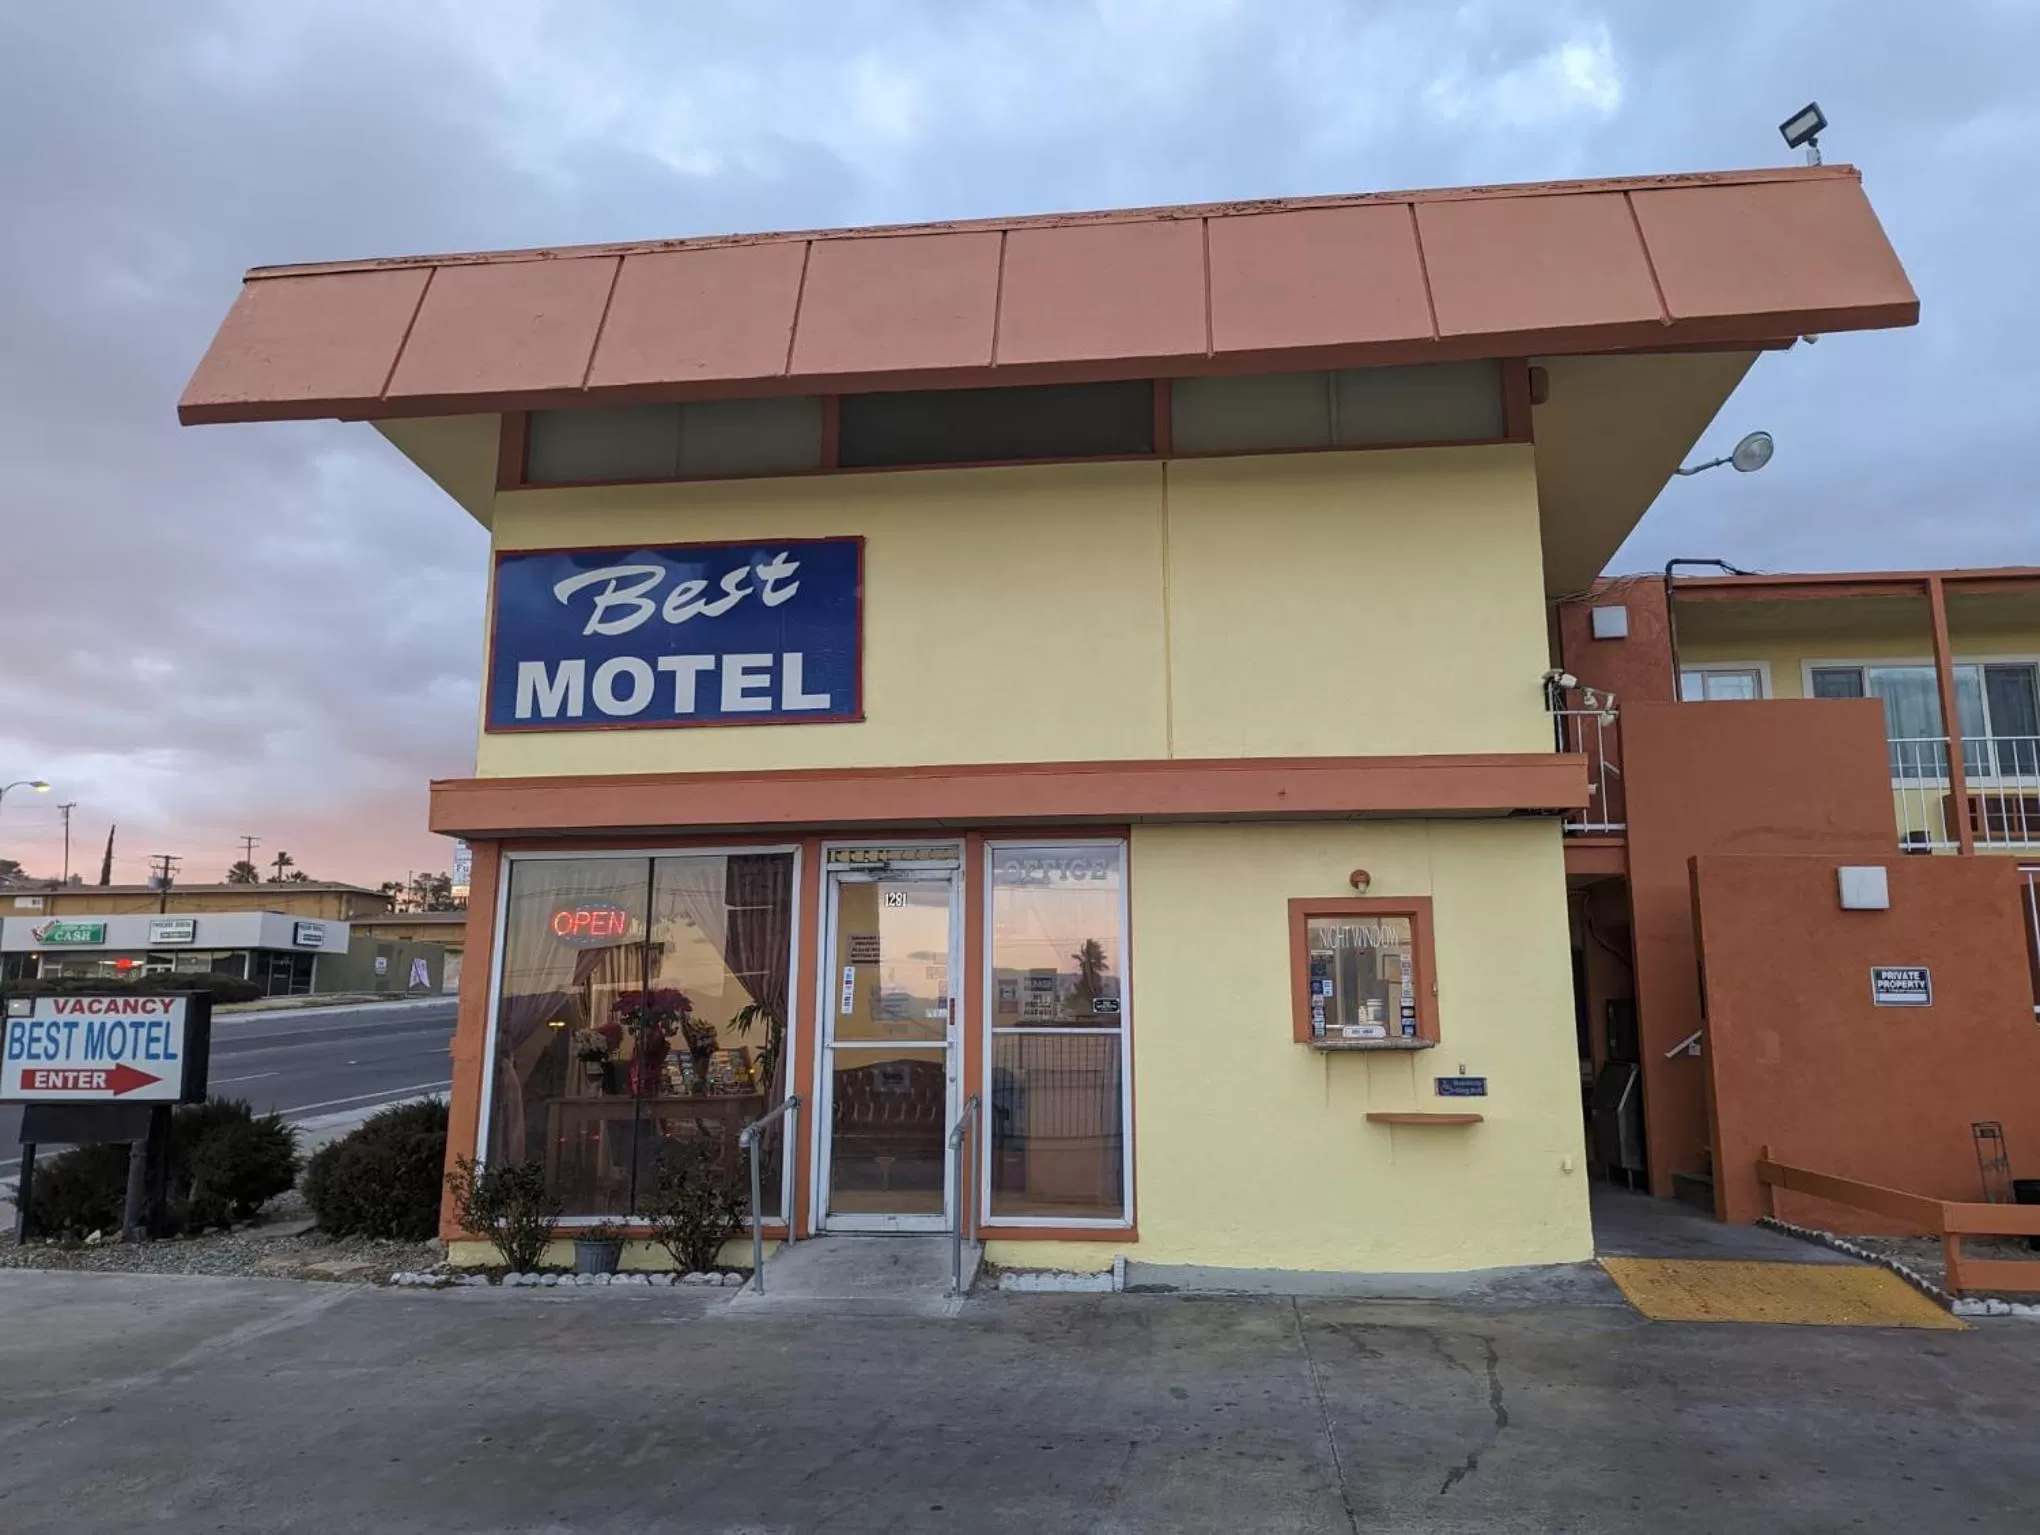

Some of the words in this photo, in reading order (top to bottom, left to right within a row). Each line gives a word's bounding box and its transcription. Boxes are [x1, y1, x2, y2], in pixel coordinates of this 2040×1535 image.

[553, 551, 800, 636] Best
[515, 652, 831, 719] MOTEL
[1004, 859, 1107, 881] OFFICE
[885, 892, 907, 907] 1281
[554, 911, 625, 936] OPEN
[54, 930, 91, 941] CASH
[1320, 925, 1350, 949] NIGHT
[1351, 925, 1399, 949] WINDOW
[1877, 980, 1925, 989] PROPERTY
[1881, 971, 1920, 980] PRIVATE
[53, 999, 176, 1014] VACANCY
[7, 1021, 79, 1060] BEST
[84, 1021, 178, 1060] MOTEL
[34, 1071, 107, 1089] ENTER
